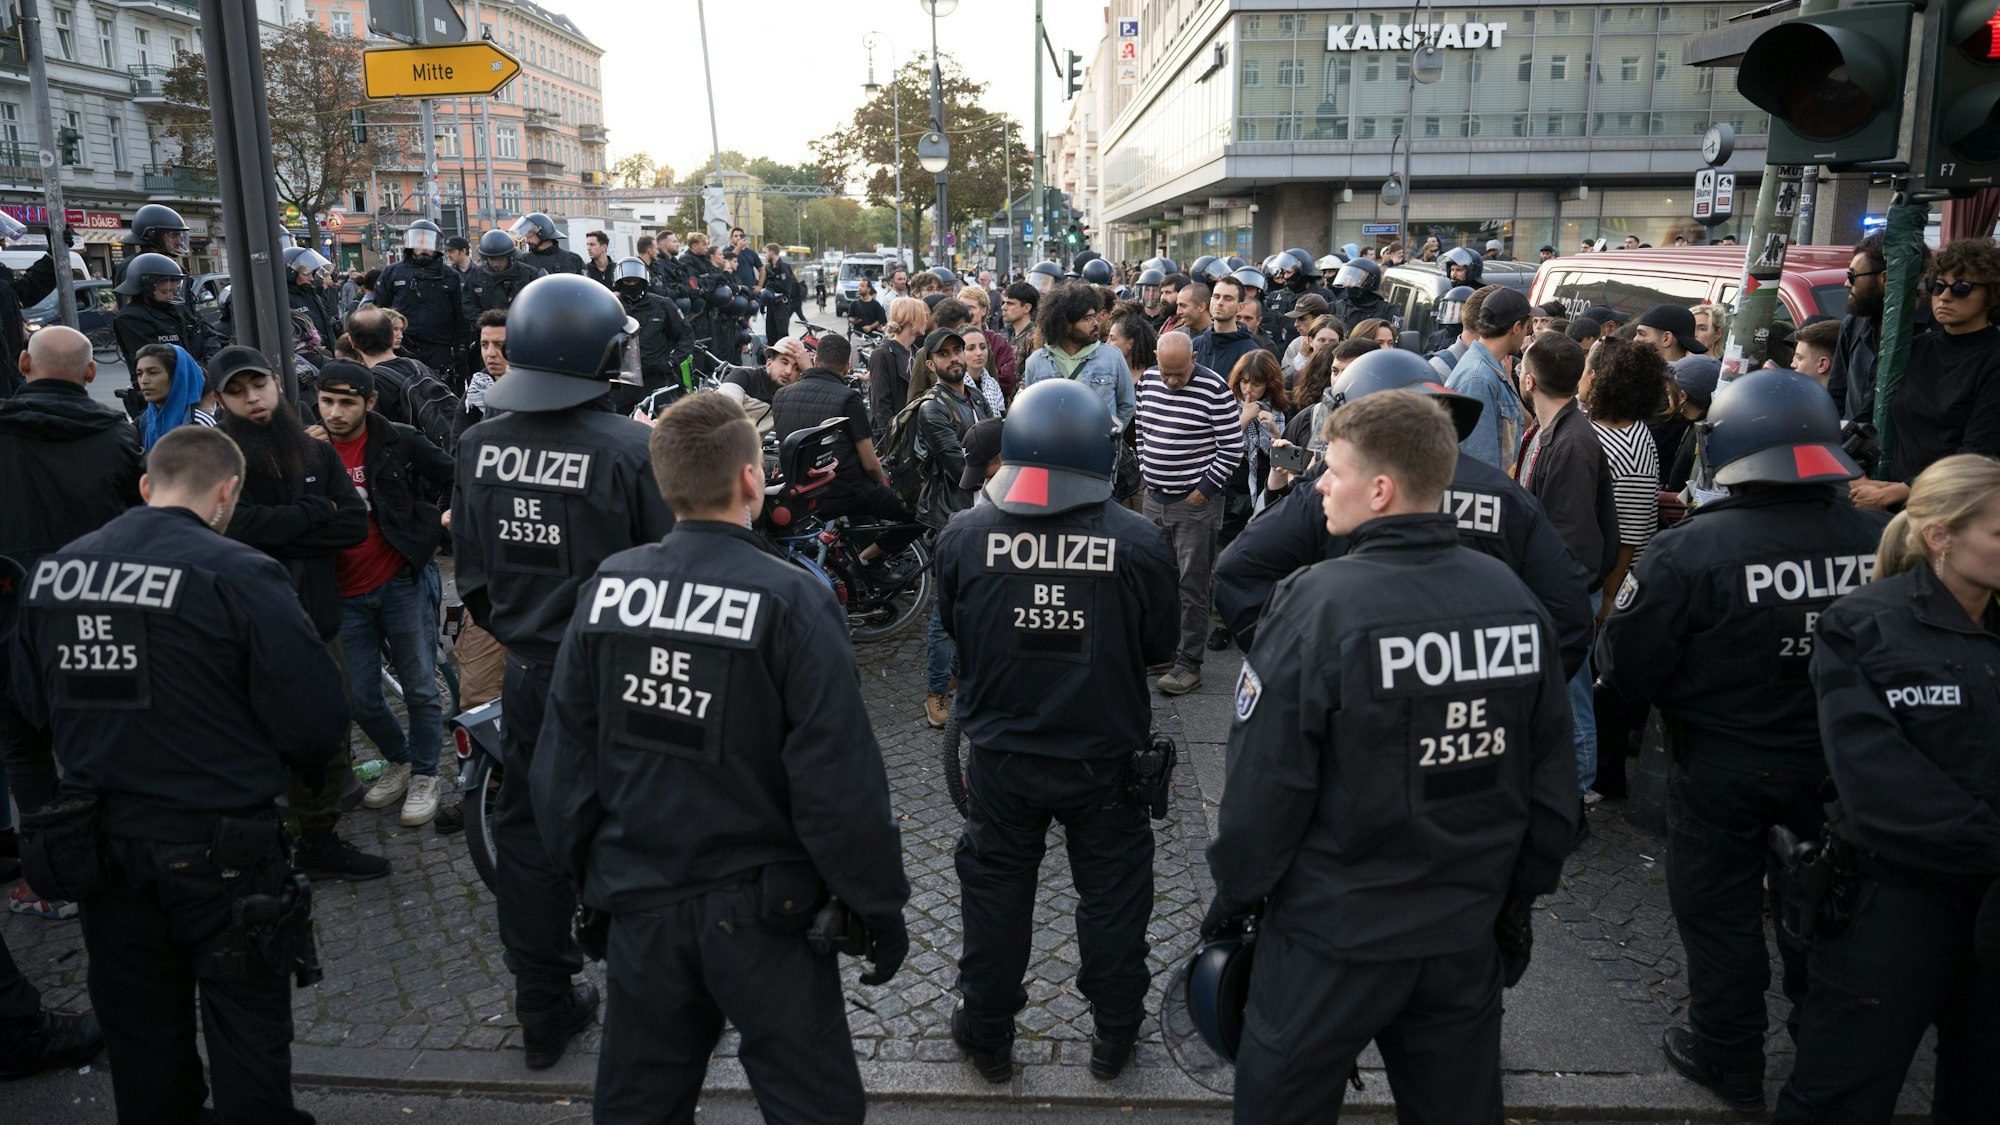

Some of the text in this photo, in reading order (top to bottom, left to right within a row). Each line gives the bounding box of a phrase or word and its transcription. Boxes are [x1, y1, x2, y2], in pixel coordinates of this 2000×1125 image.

[1327, 22, 1507, 50] KARSTADT
[412, 63, 454, 81] Mitte
[1940, 163, 1956, 177] F7
[1696, 189, 1712, 198] Blume
[91, 214, 119, 228] DÖNER
[157, 334, 180, 342] POLIZEI
[475, 444, 590, 489] POLIZEI
[513, 497, 542, 520] BE
[1442, 490, 1501, 533] IZEI
[498, 519, 561, 545] 25328
[986, 532, 1116, 572] POLIZEI
[29, 559, 183, 609] POLIZEI
[1745, 554, 1879, 603] POLIZE
[1034, 583, 1066, 606] BE
[589, 577, 761, 642] POLIZEI
[1013, 607, 1085, 630] 25325
[1805, 611, 1821, 633] B
[76, 615, 114, 640] BE
[57, 644, 138, 670] 25125
[649, 646, 692, 682] BE
[1379, 623, 1540, 689] POLIZEI
[622, 673, 712, 719] 25127
[1885, 685, 1962, 709] POLIZEI
[1445, 698, 1488, 730] BE
[1418, 726, 1507, 767] 25128
